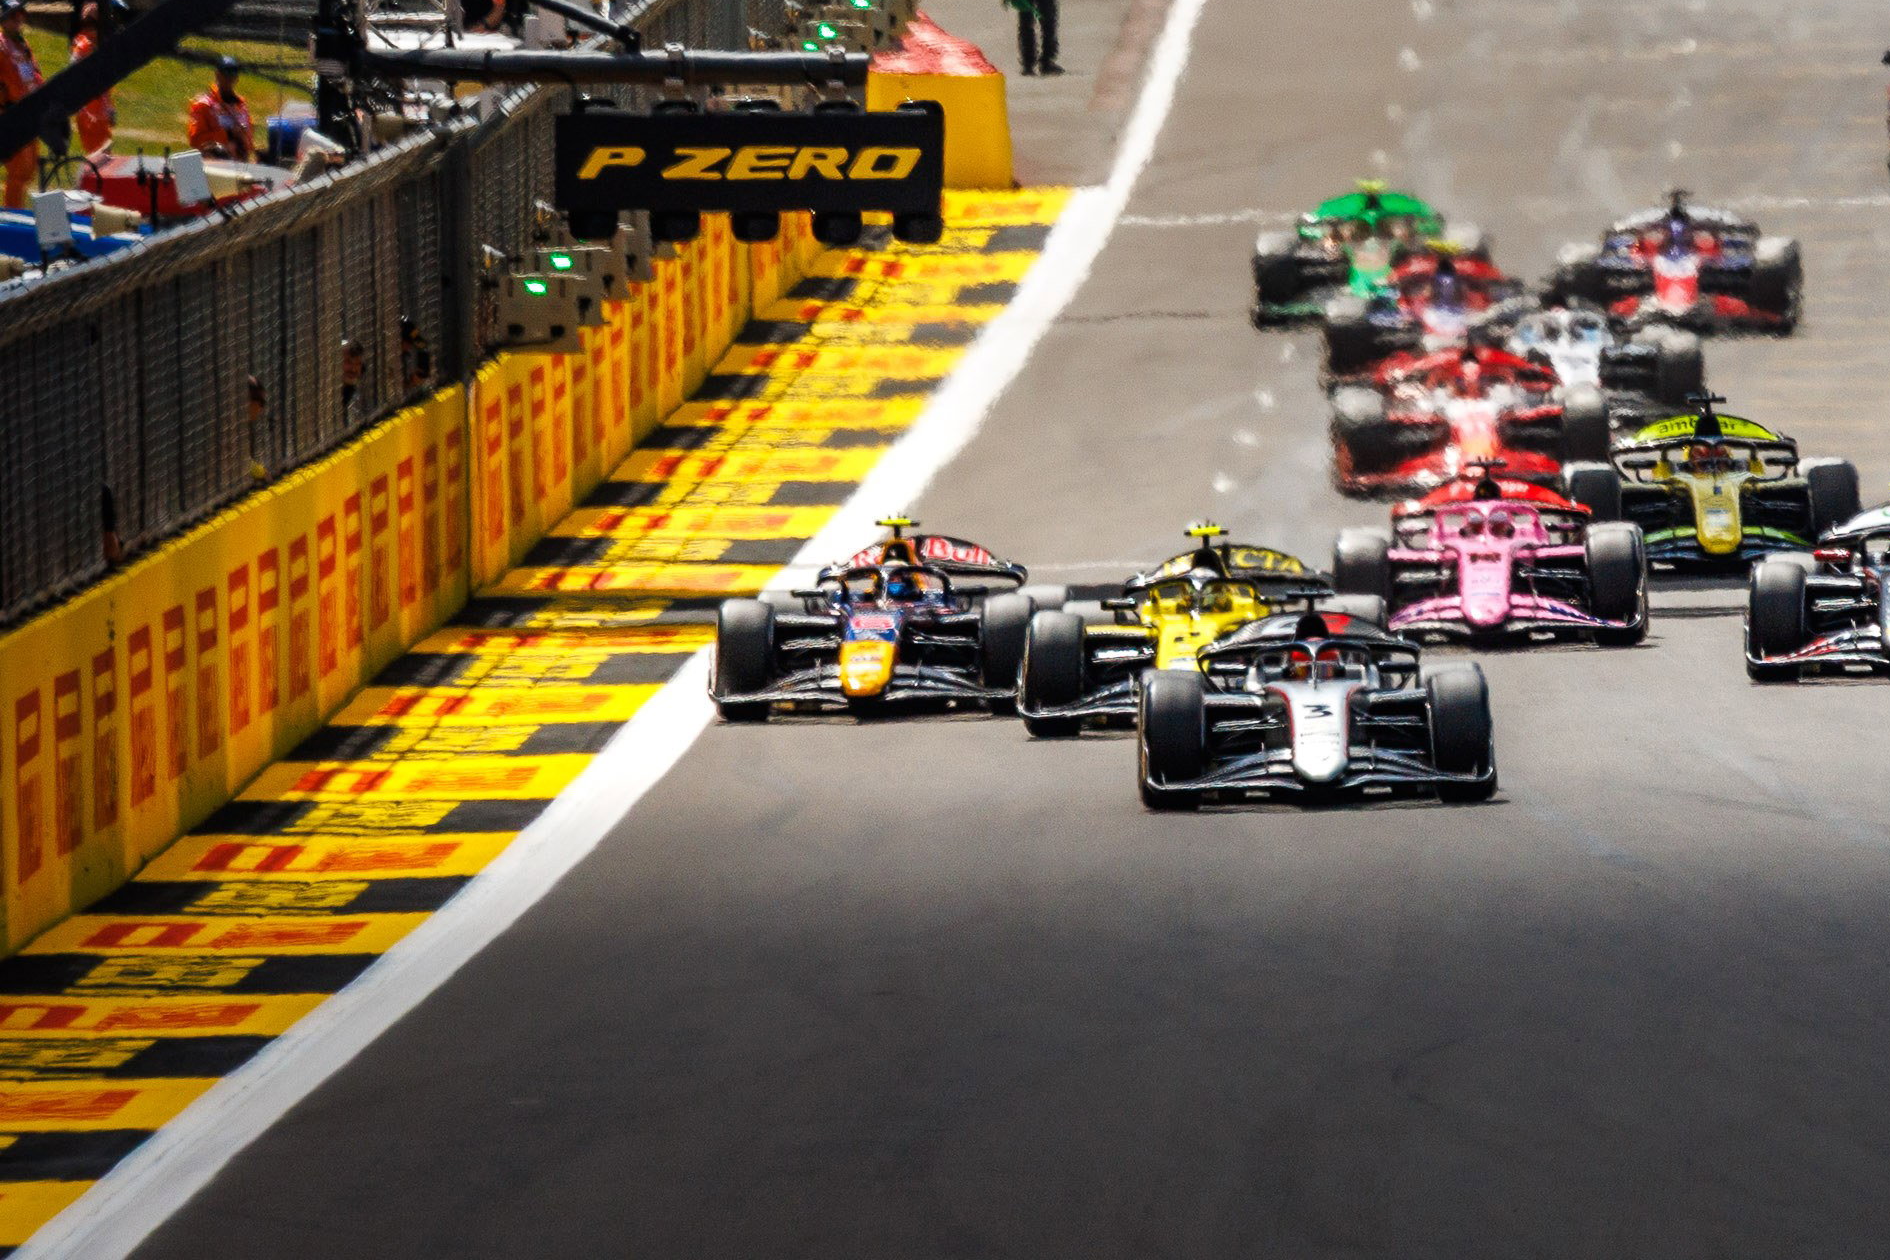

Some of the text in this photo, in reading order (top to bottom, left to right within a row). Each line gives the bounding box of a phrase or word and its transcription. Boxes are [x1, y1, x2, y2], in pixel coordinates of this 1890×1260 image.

[577, 144, 922, 181] P ZERO
[1303, 704, 1334, 719] 3
